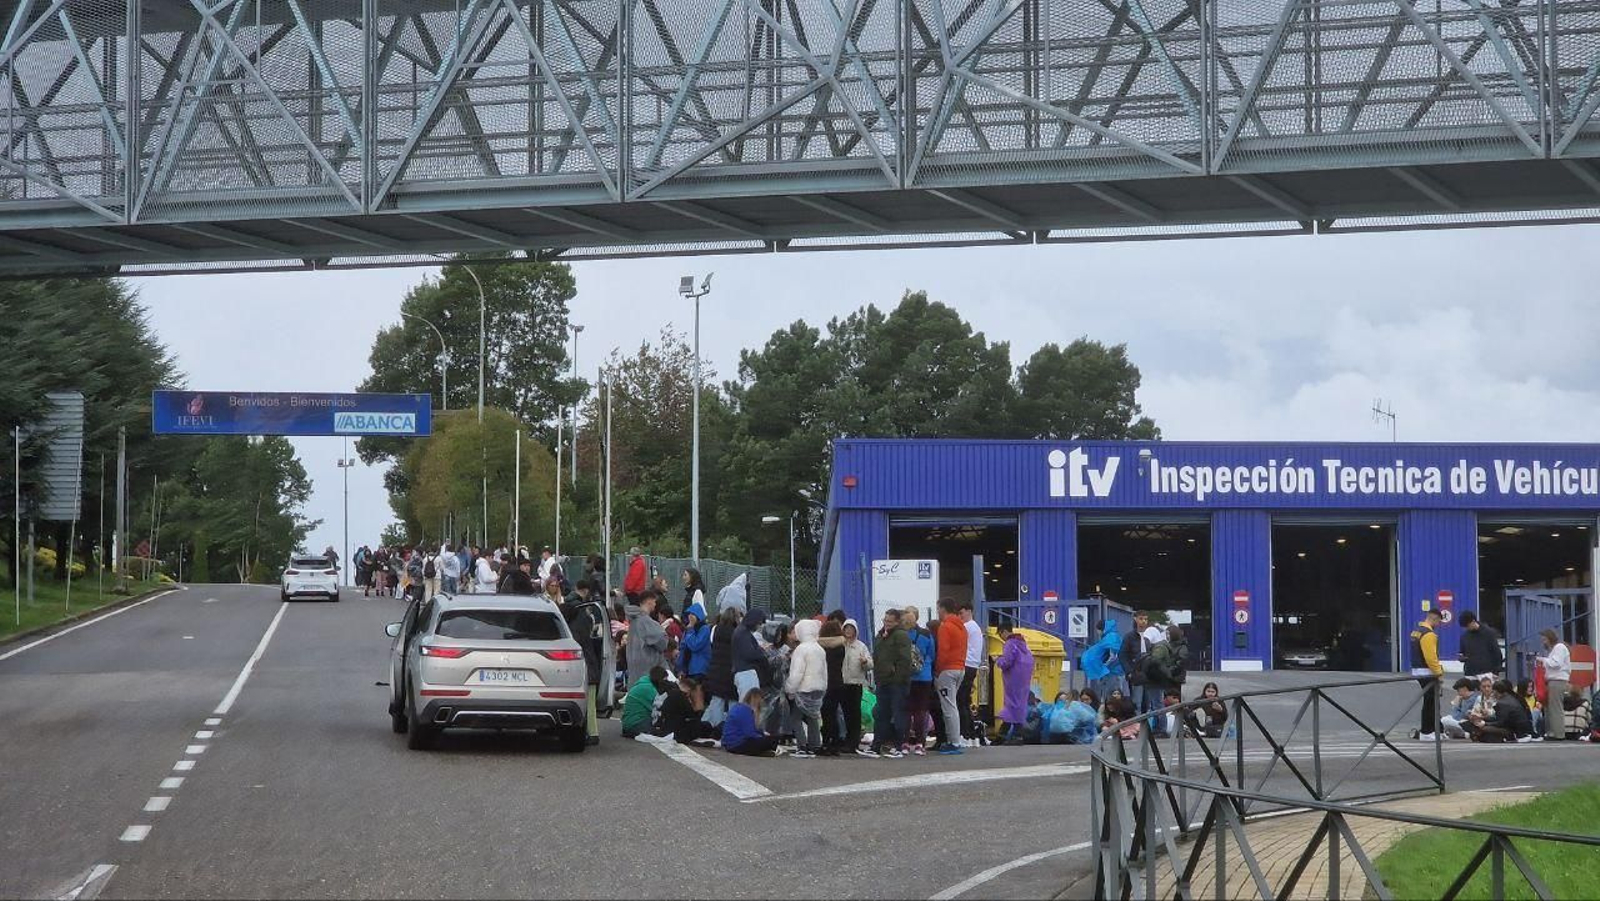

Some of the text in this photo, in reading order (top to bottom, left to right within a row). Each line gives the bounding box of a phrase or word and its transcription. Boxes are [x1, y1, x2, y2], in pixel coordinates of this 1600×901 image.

[229, 396, 280, 407] Benvidos
[290, 396, 357, 408] Bienvenidos
[1048, 446, 1121, 497] itv
[1150, 458, 1315, 501] Inspección
[1322, 459, 1442, 494] Tecnica
[1450, 459, 1487, 494] de
[485, 671, 528, 682] 4302 MCL
